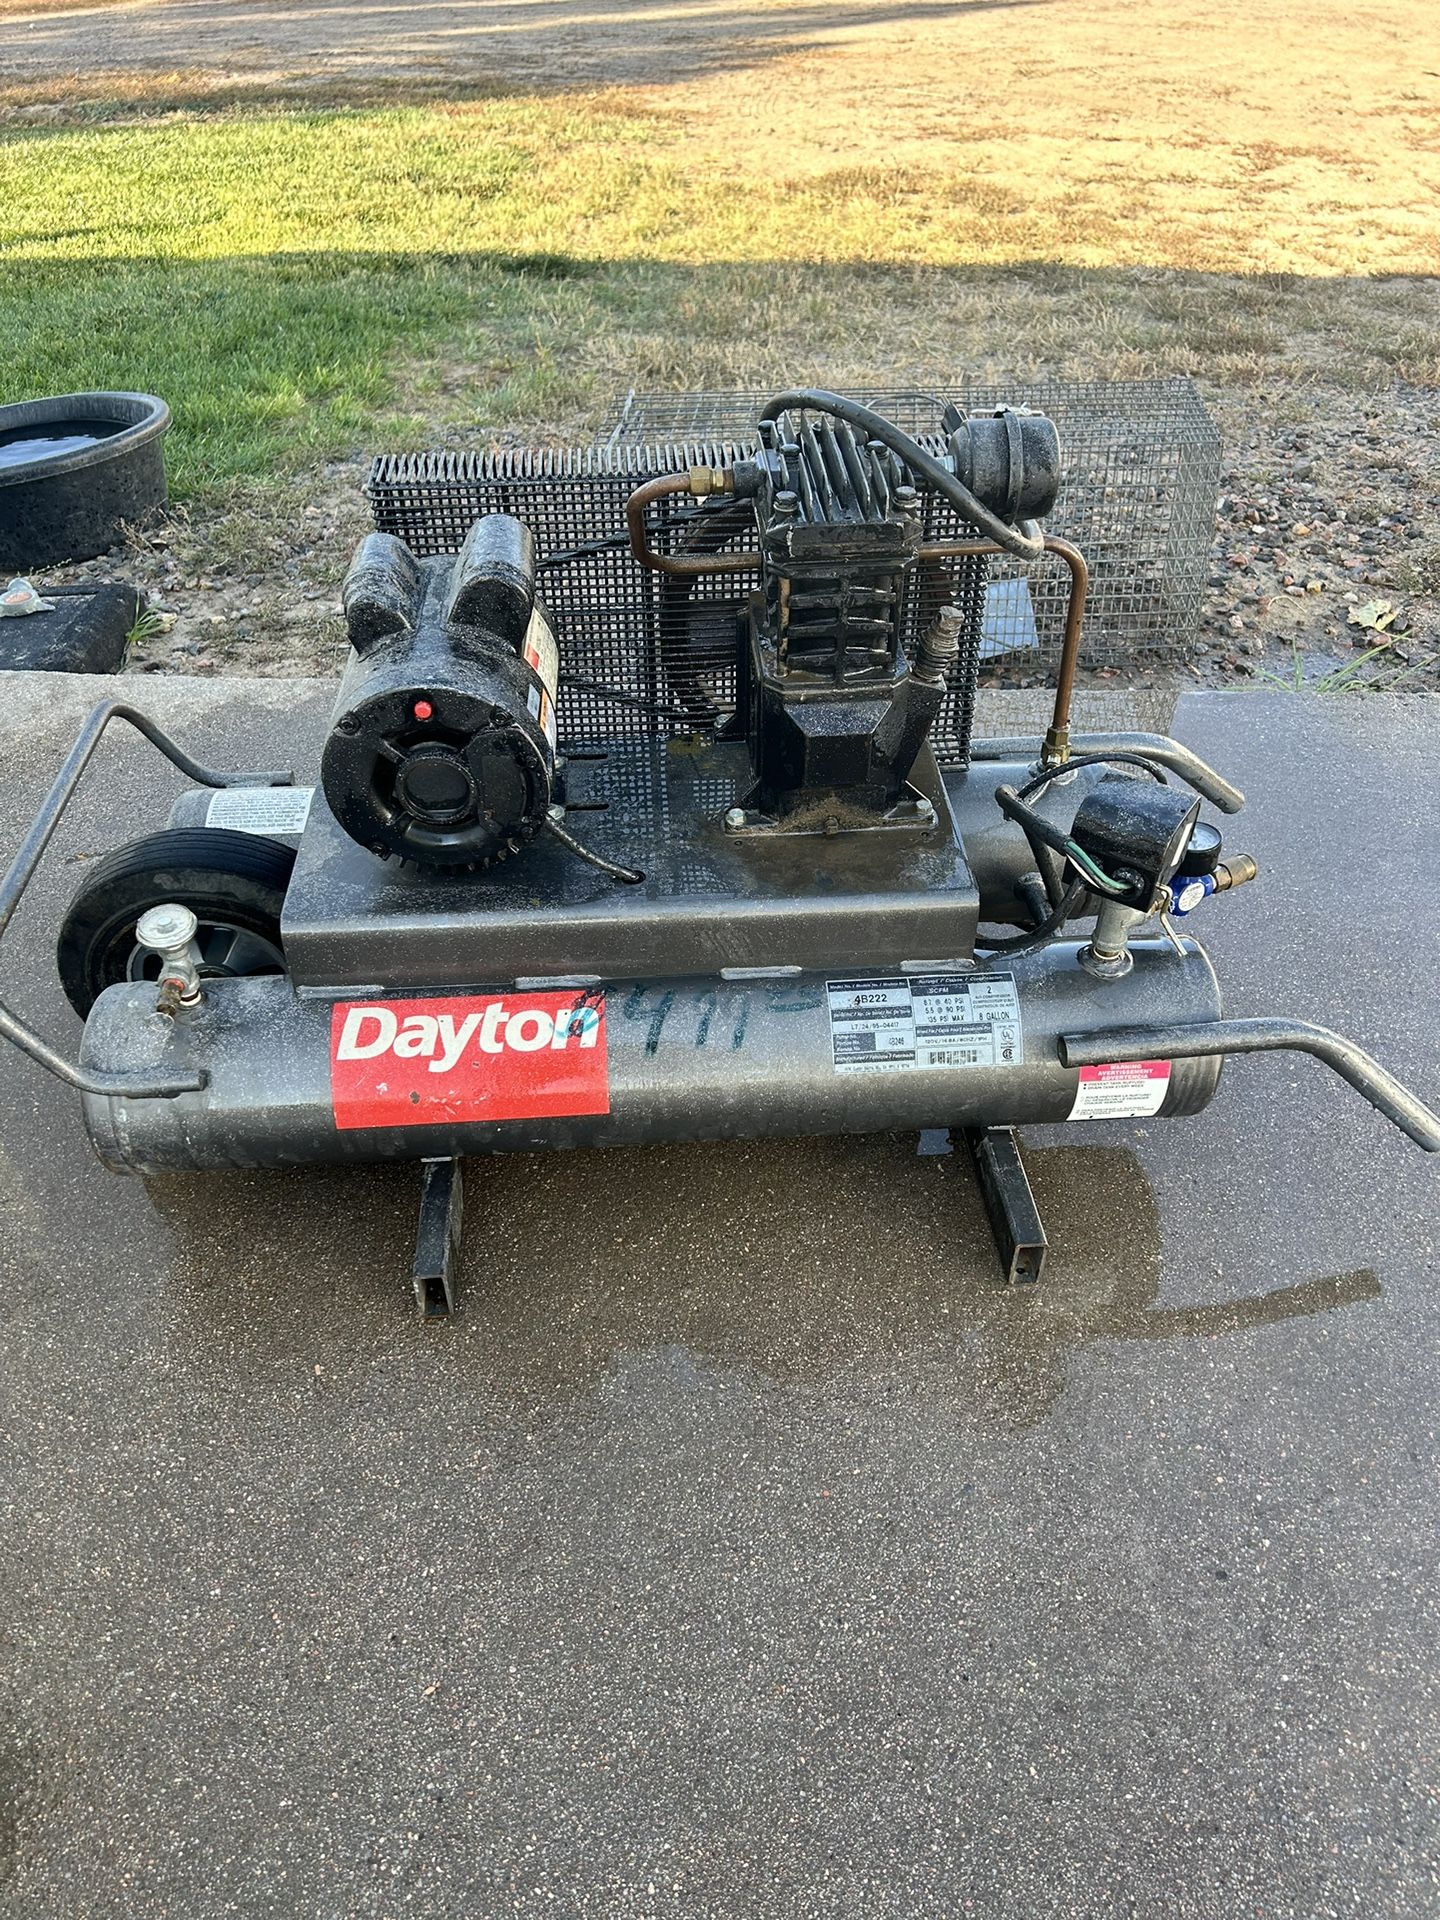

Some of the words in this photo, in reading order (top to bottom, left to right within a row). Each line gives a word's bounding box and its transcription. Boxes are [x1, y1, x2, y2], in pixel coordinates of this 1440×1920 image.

[987, 985, 992, 994] 2
[854, 993, 887, 1005] 4B222
[986, 1011, 1010, 1021] GALLON
[336, 1002, 601, 1073] Dayton
